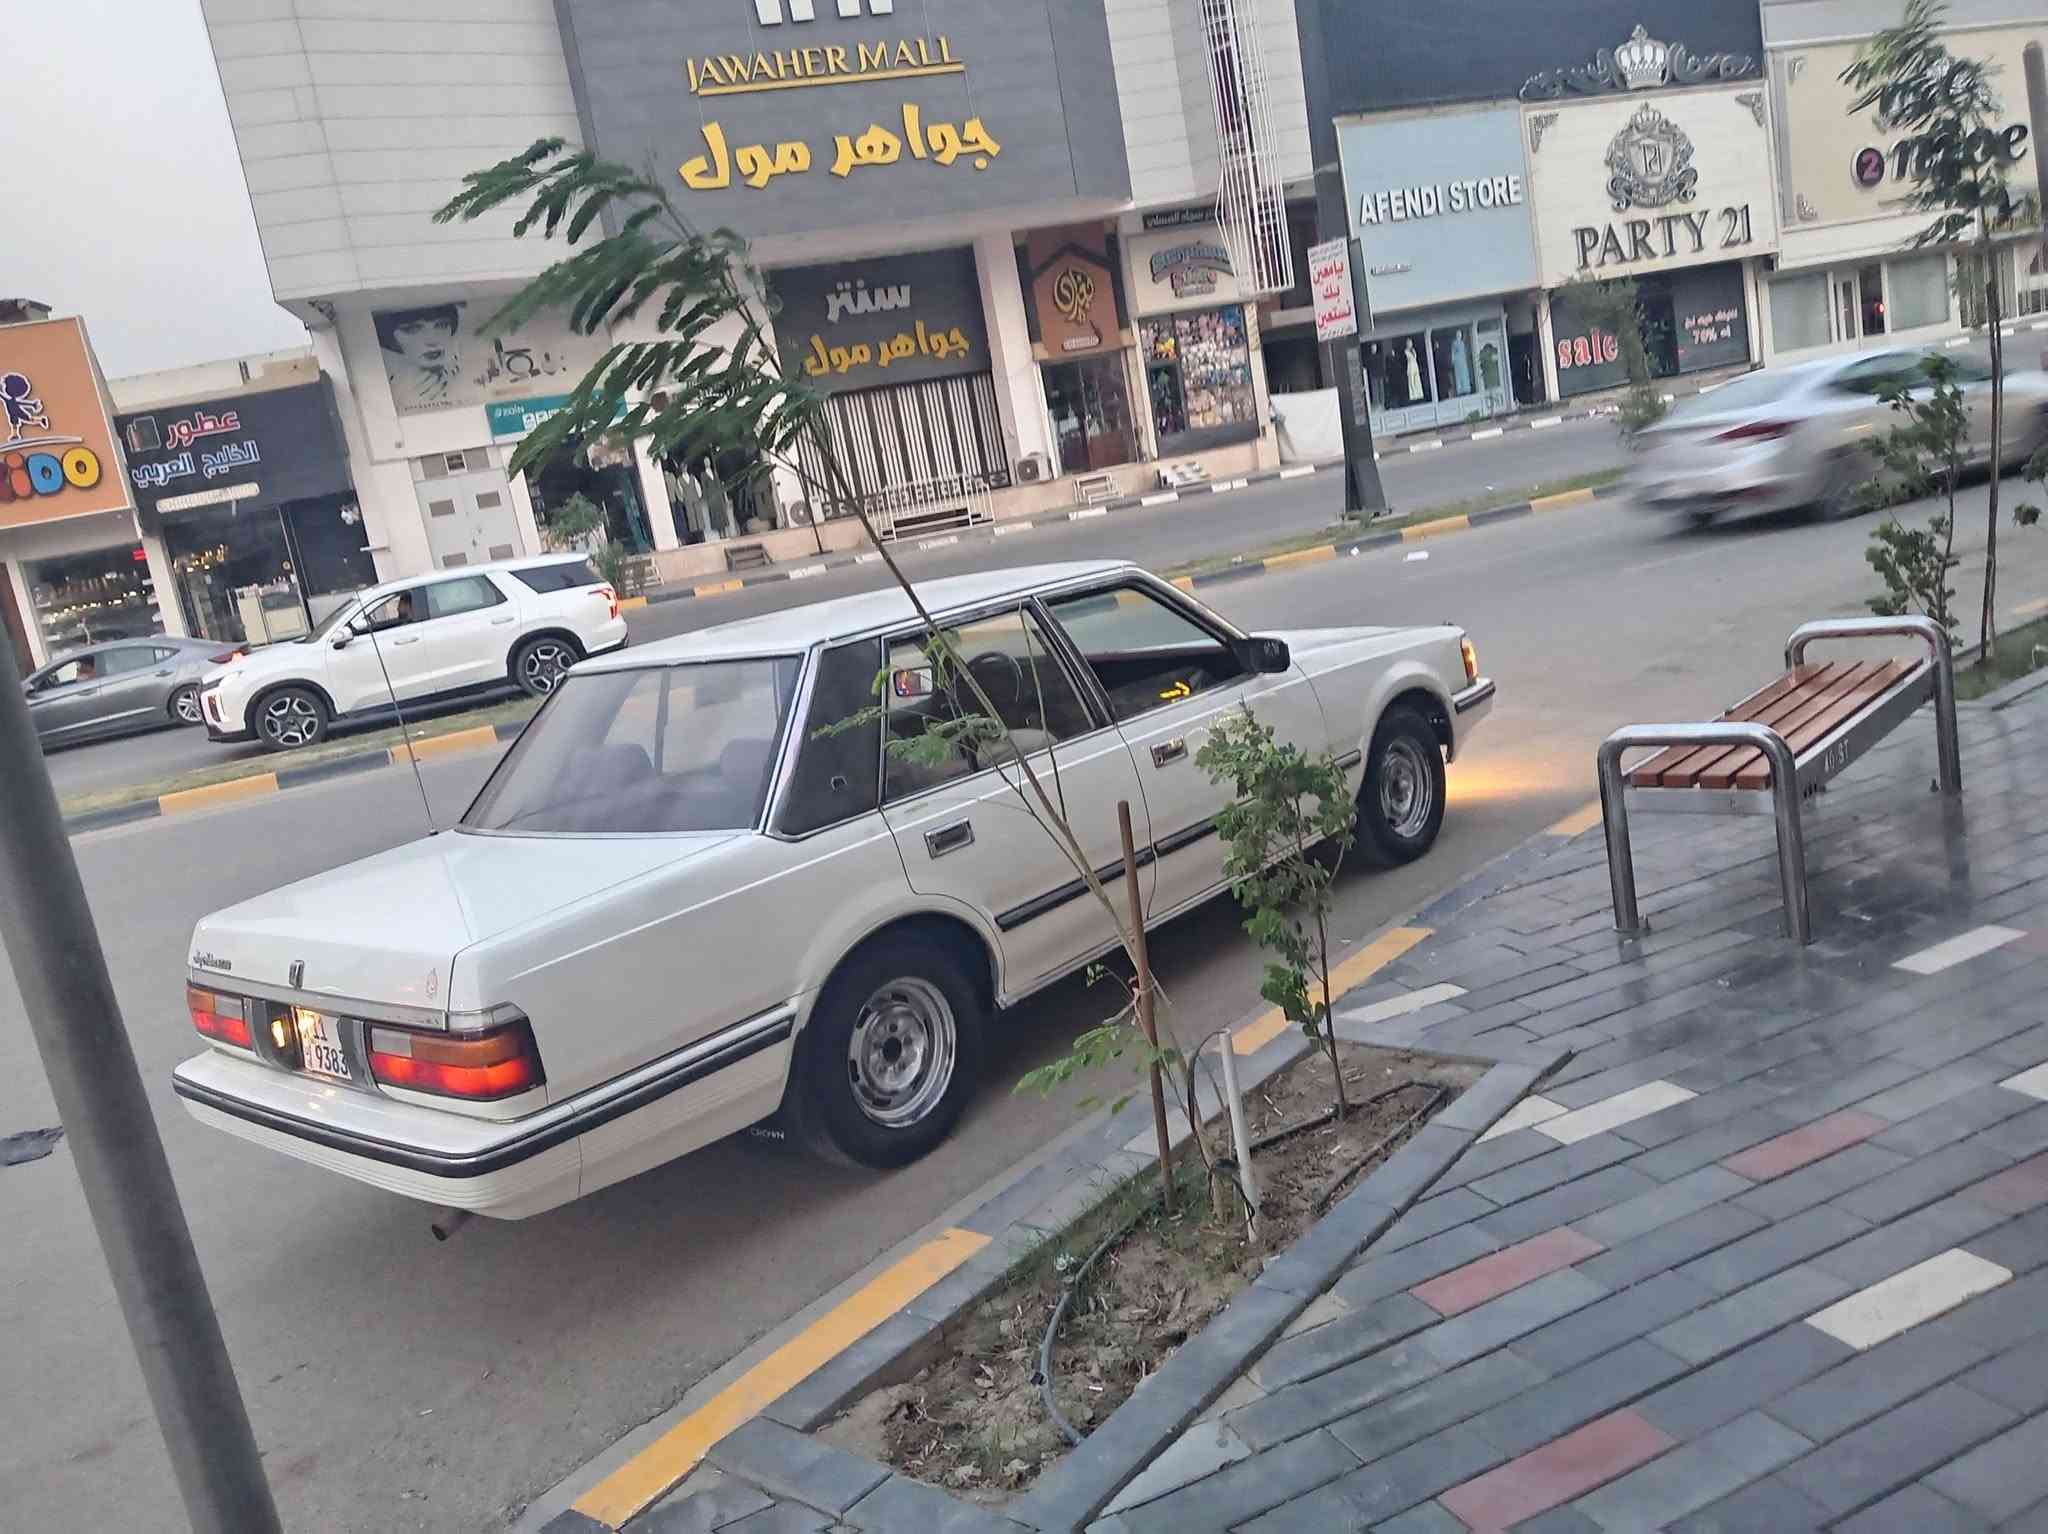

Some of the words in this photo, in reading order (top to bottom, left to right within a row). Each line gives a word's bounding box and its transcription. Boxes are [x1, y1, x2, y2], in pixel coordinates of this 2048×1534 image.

[686, 43, 850, 93] JAWAHER
[857, 35, 963, 73] MALL
[678, 120, 812, 190] مول
[829, 103, 1000, 178] جواهر
[1360, 183, 1444, 226] AFENDI
[1449, 174, 1523, 213] STORE
[1571, 208, 1711, 270] PARTY
[1718, 203, 1752, 249] 21
[826, 278, 912, 324] سنتر
[804, 333, 871, 377] مول
[878, 319, 970, 368] جواهر
[1558, 326, 1619, 369] sale
[166, 410, 241, 450] عطور
[131, 451, 196, 488] العربي
[201, 440, 261, 479] الخليج
